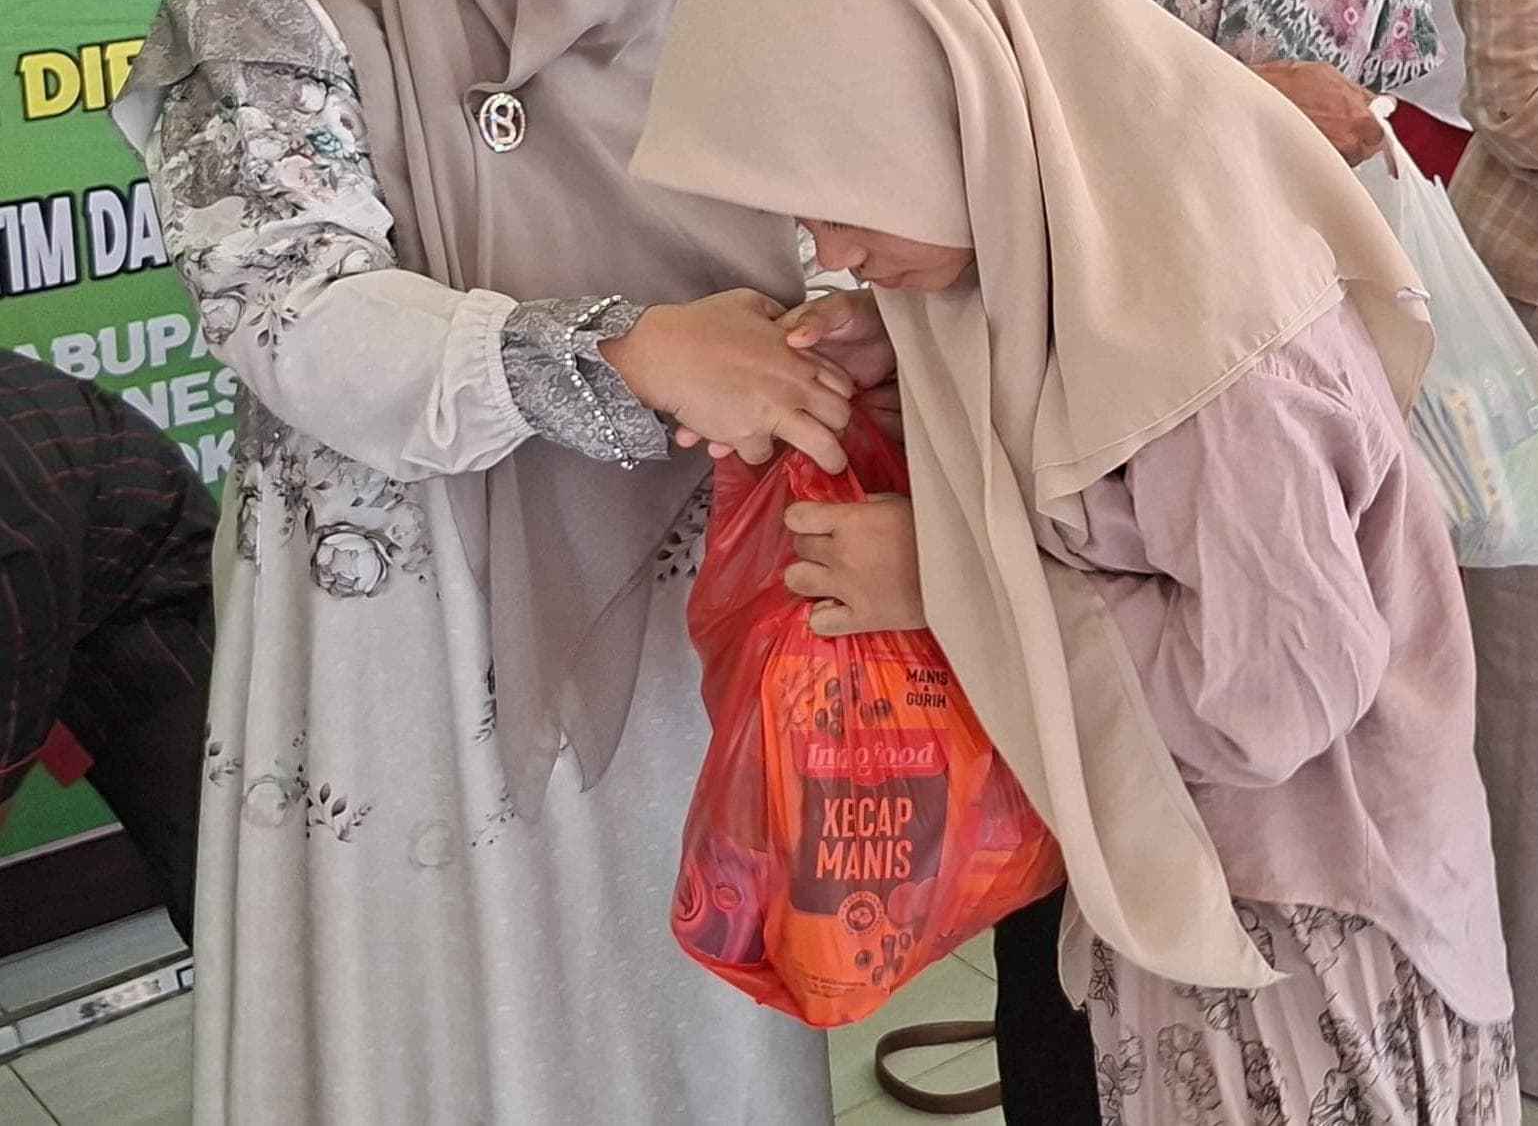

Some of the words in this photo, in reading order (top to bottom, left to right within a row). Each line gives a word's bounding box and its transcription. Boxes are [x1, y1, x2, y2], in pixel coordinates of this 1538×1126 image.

[0, 195, 78, 294] IM
[13, 313, 209, 380] BUP
[906, 667, 949, 686] MANIS
[906, 692, 947, 708] GURIH
[822, 797, 913, 837] KECAP
[815, 839, 913, 880] MANIS
